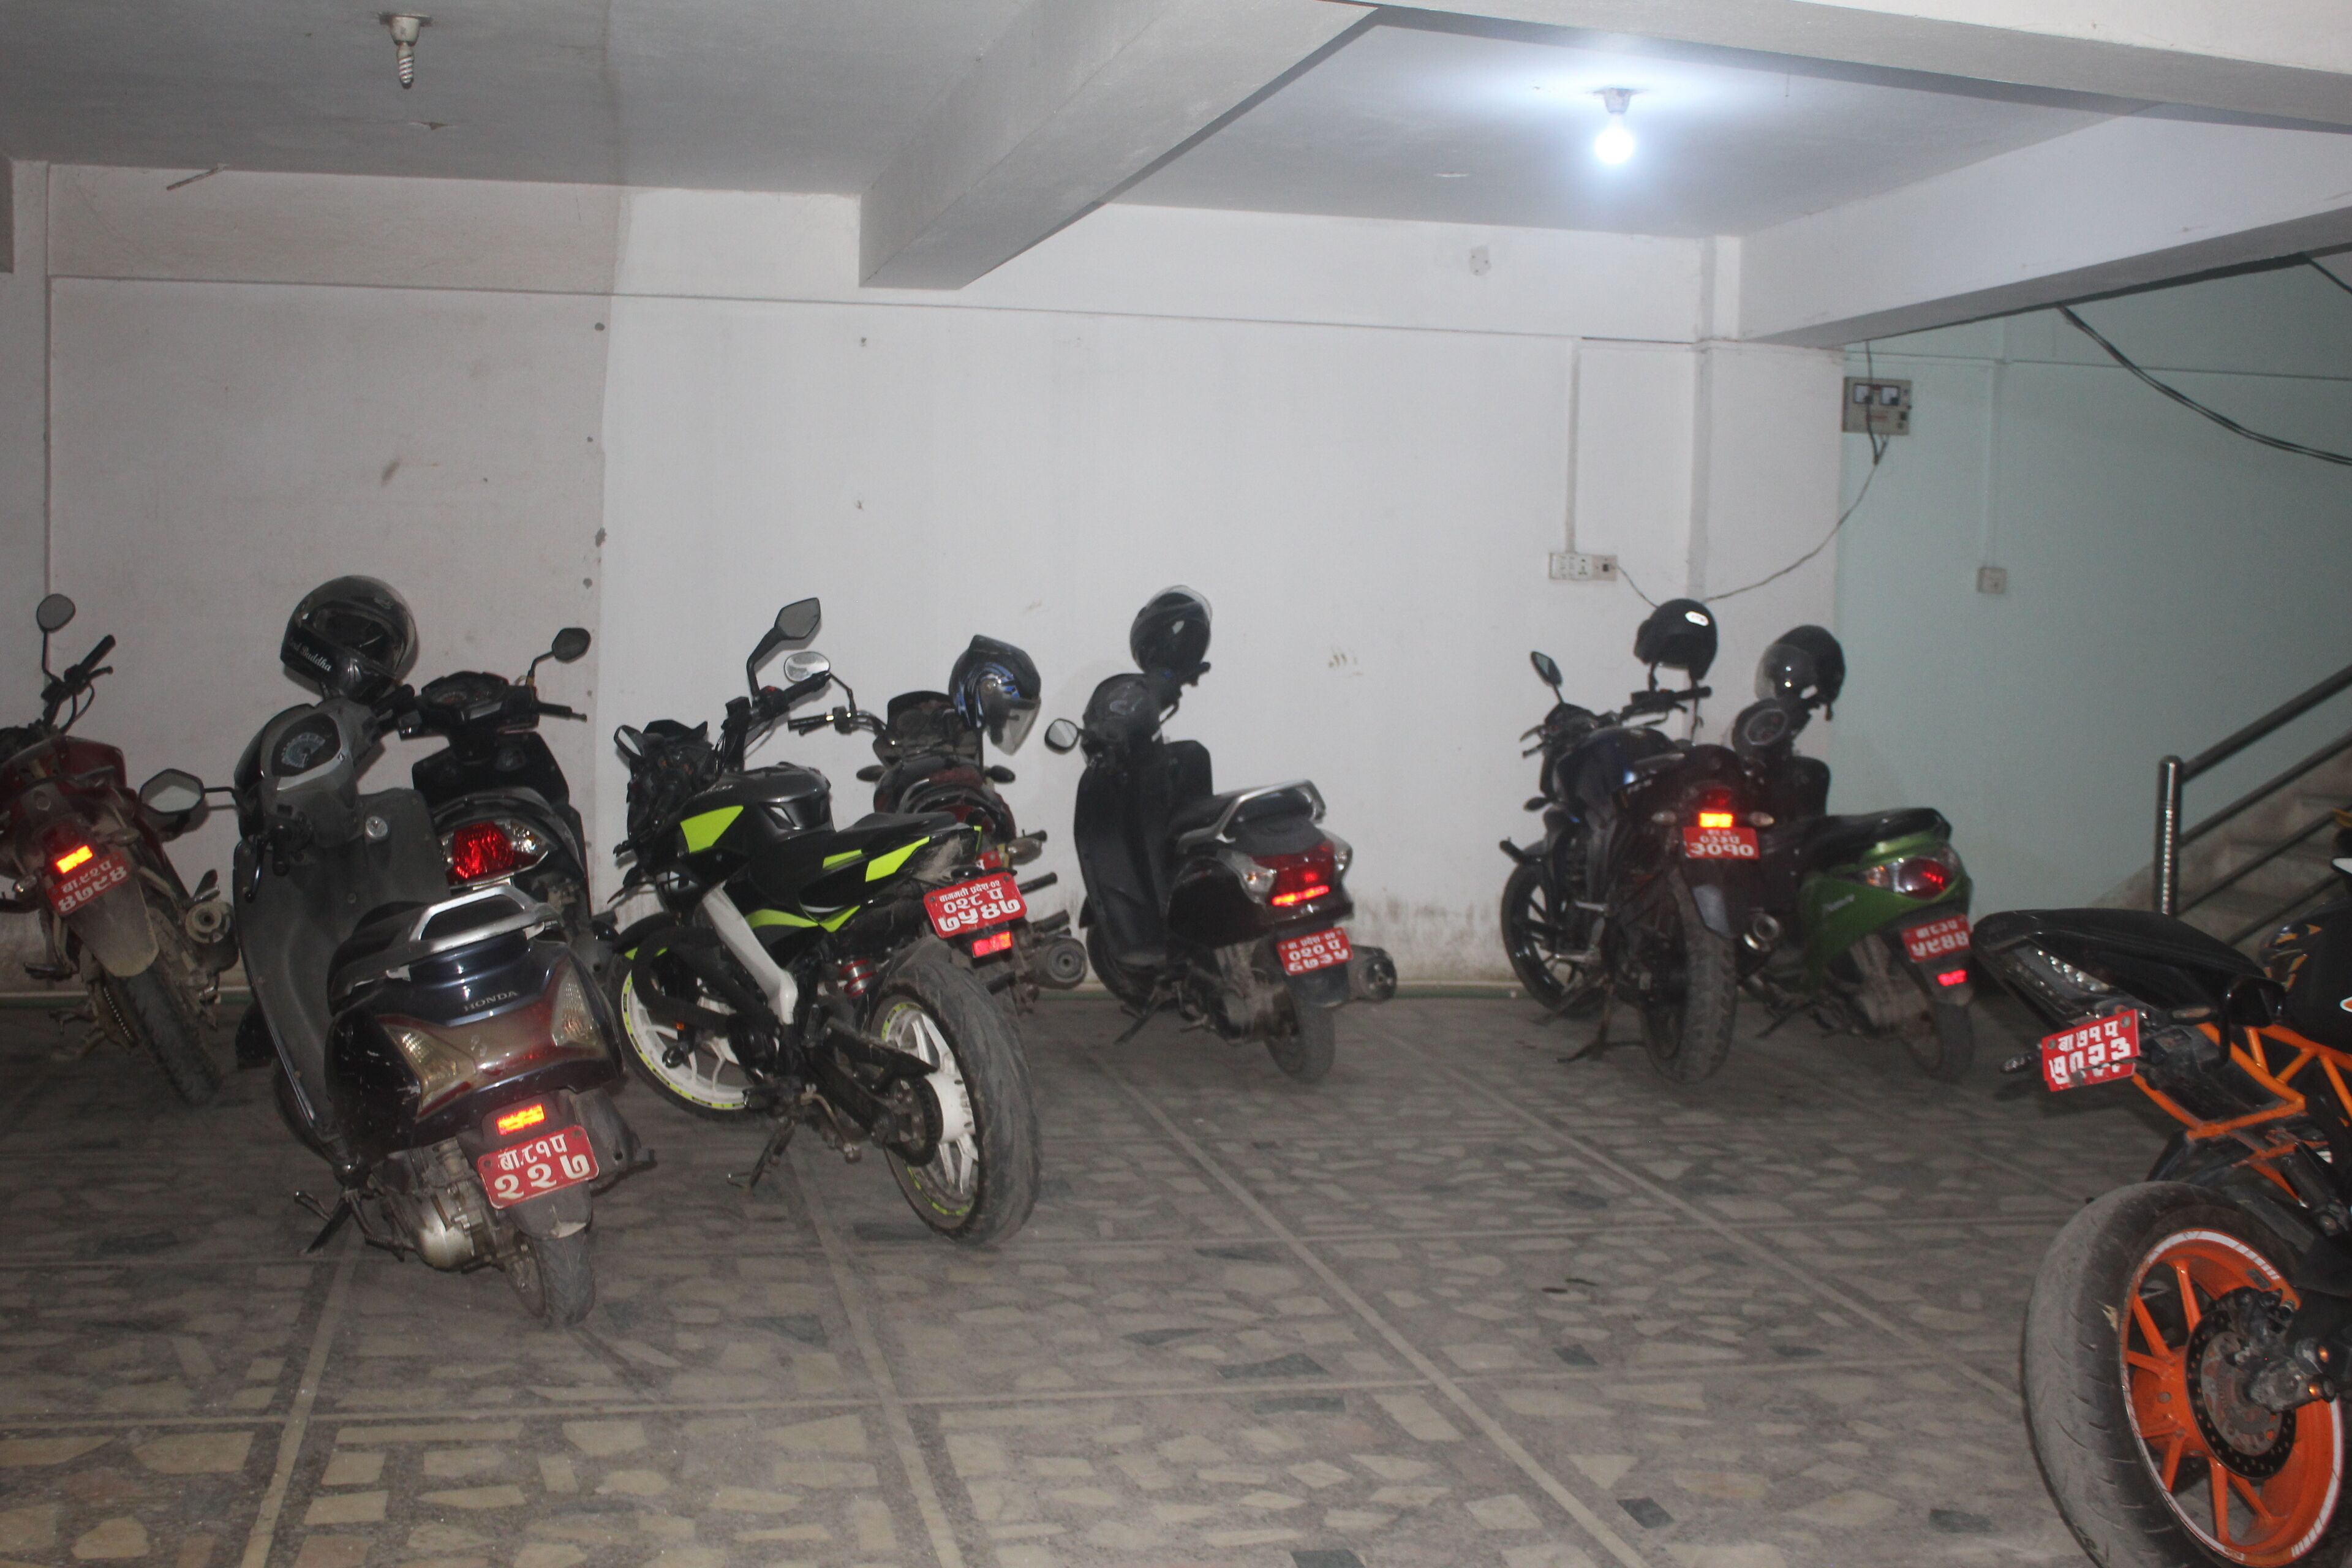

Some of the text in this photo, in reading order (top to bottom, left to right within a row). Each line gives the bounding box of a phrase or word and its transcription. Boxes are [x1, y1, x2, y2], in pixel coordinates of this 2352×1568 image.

[938, 899, 1020, 932] ७५४७
[464, 991, 518, 1011] HONDA
[494, 1154, 590, 1200] २२७
